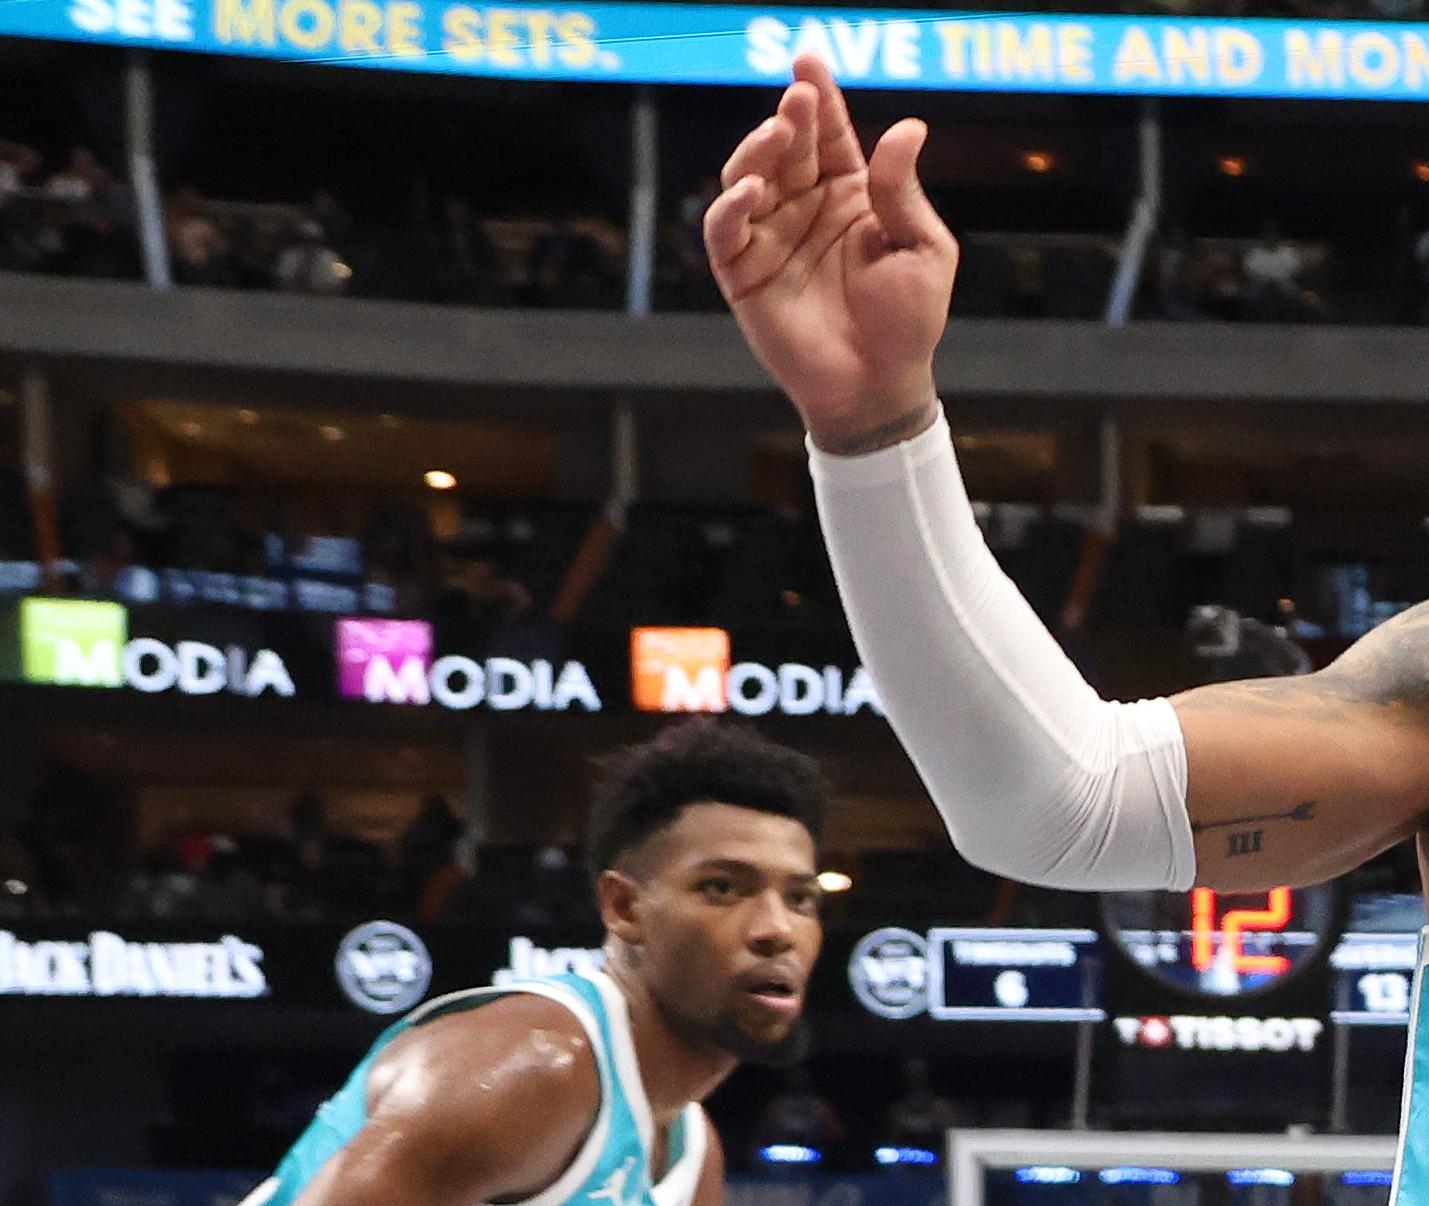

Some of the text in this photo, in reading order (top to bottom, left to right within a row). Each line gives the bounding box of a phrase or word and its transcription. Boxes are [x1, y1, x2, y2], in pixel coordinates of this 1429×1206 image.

[214, 0, 425, 57] MORE
[441, 7, 620, 70] SETS.
[745, 15, 921, 79] SAVE
[938, 22, 1092, 80] TIME
[1112, 26, 1266, 88] AND
[54, 636, 297, 697] MODIA
[364, 655, 601, 712] MODIA
[1170, 1015, 1324, 1051] TISSOT
